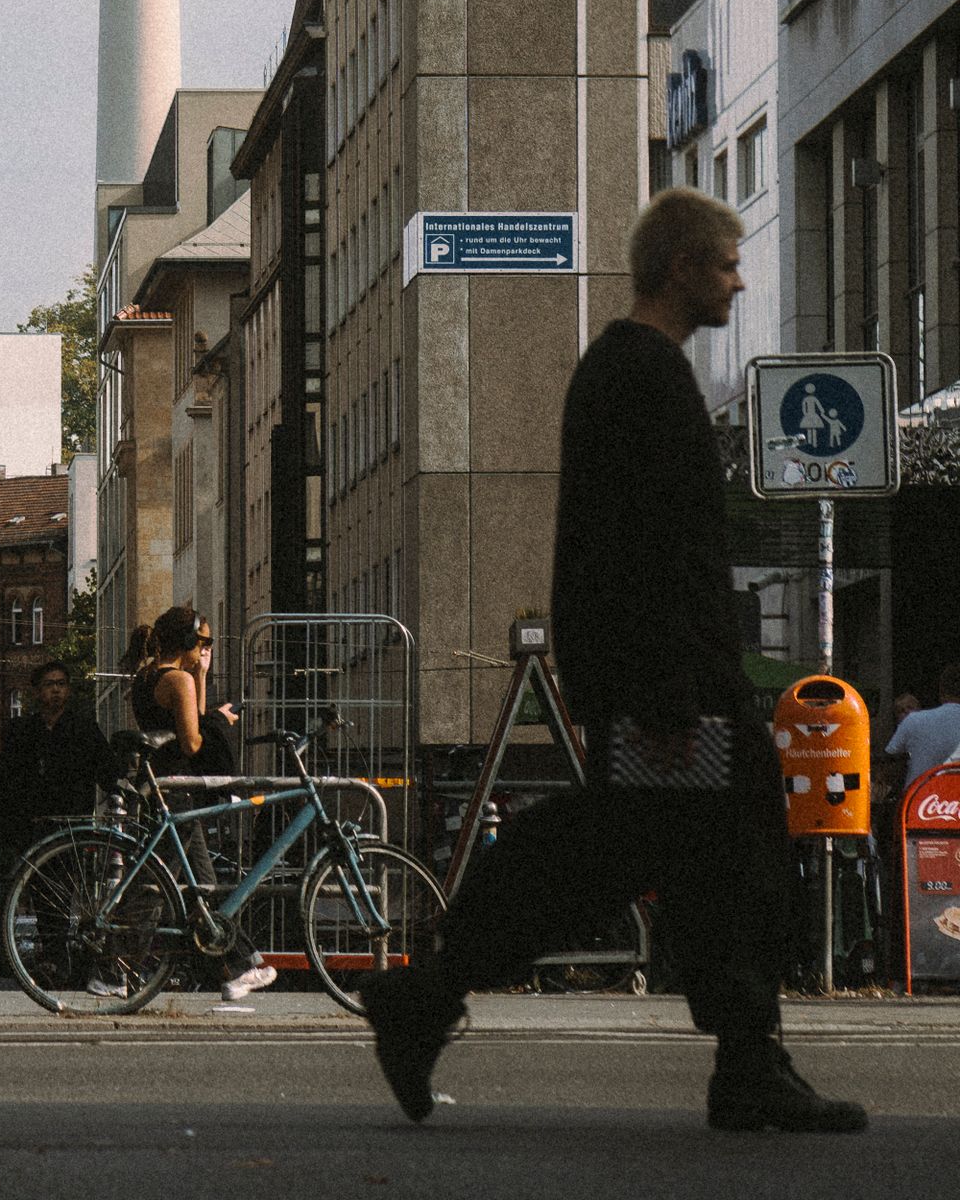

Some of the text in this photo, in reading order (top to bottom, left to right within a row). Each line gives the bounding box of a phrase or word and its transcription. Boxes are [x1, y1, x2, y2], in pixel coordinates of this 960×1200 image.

[425, 222, 569, 231] Internationales Handelszentrum
[465, 236, 483, 244] rund
[499, 236, 511, 244] die
[513, 236, 527, 244] Uhr
[529, 236, 562, 244] bewacht
[465, 247, 541, 256] mit Damenparkdeck
